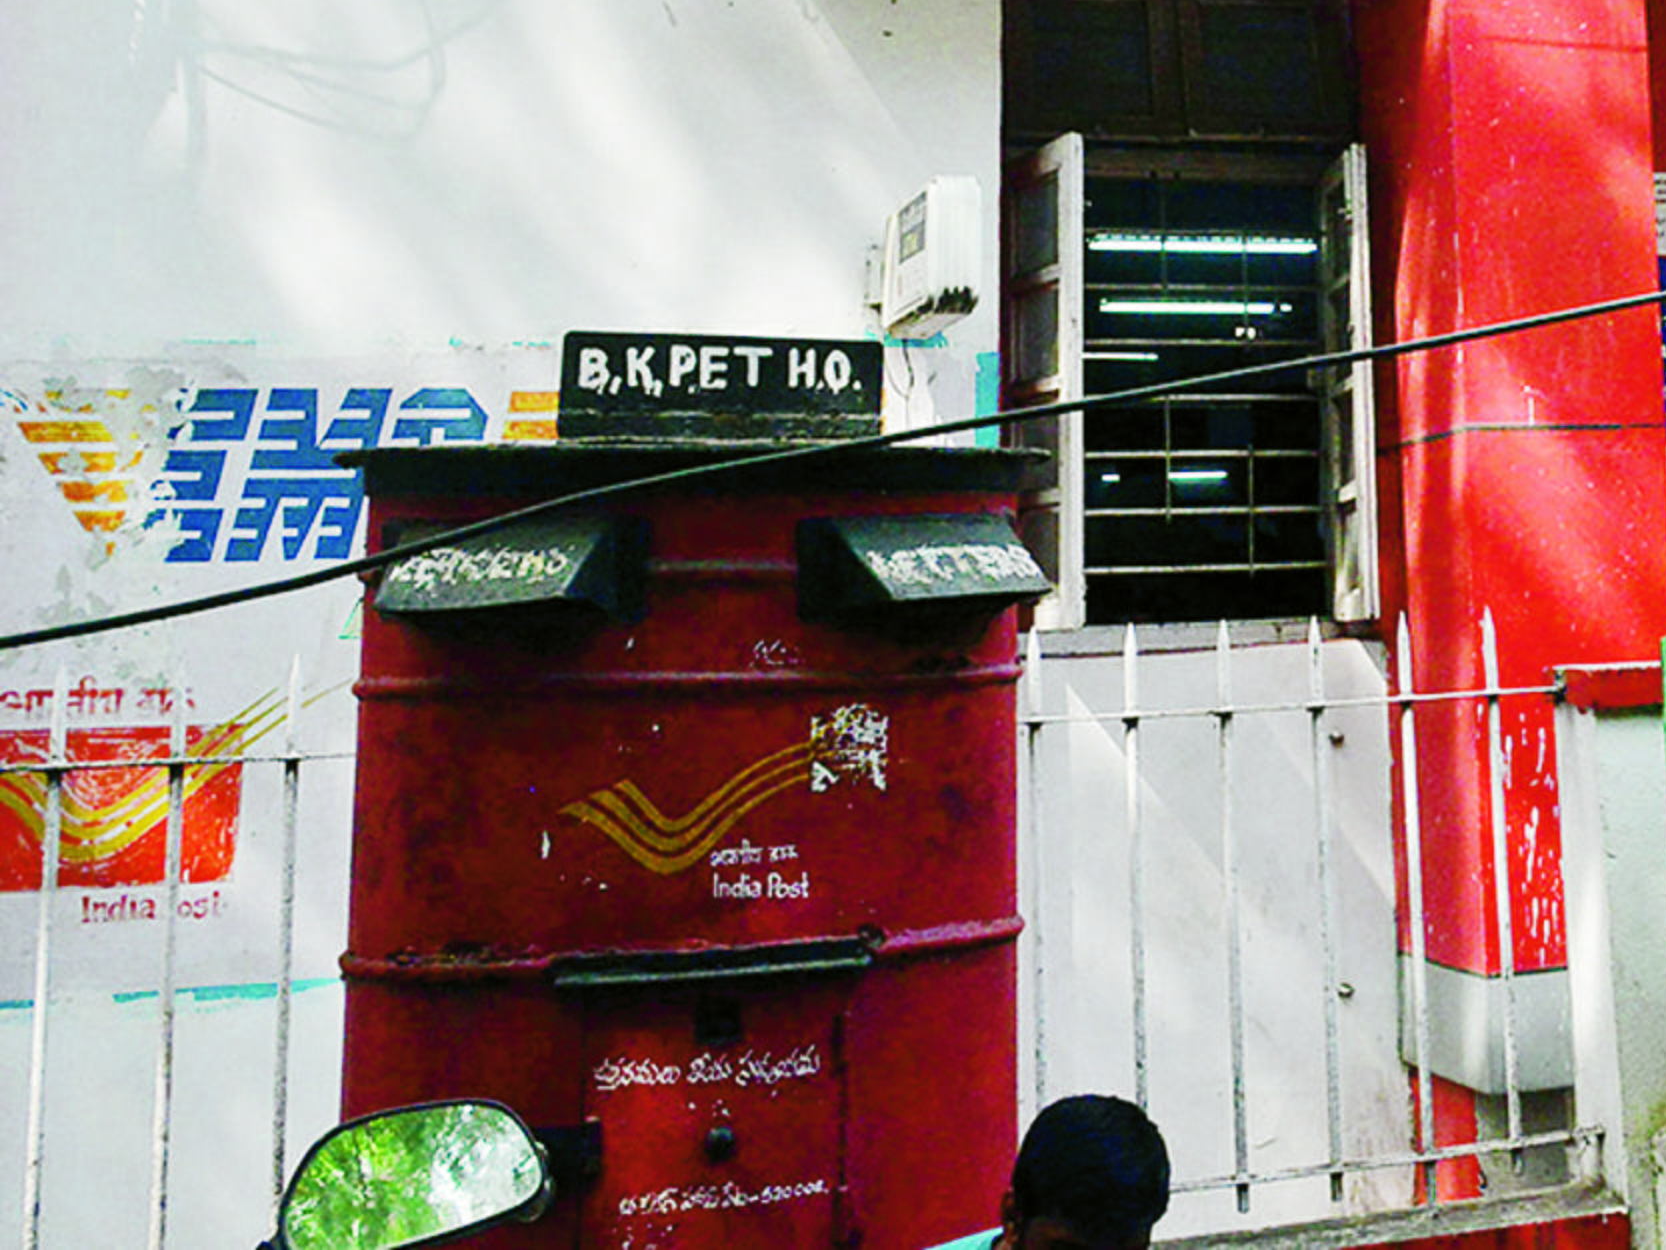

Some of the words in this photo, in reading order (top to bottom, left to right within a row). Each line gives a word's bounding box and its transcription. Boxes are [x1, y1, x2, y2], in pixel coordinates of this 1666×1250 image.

[713, 871, 762, 899] India
[767, 871, 810, 899] Post
[80, 895, 156, 924] India
